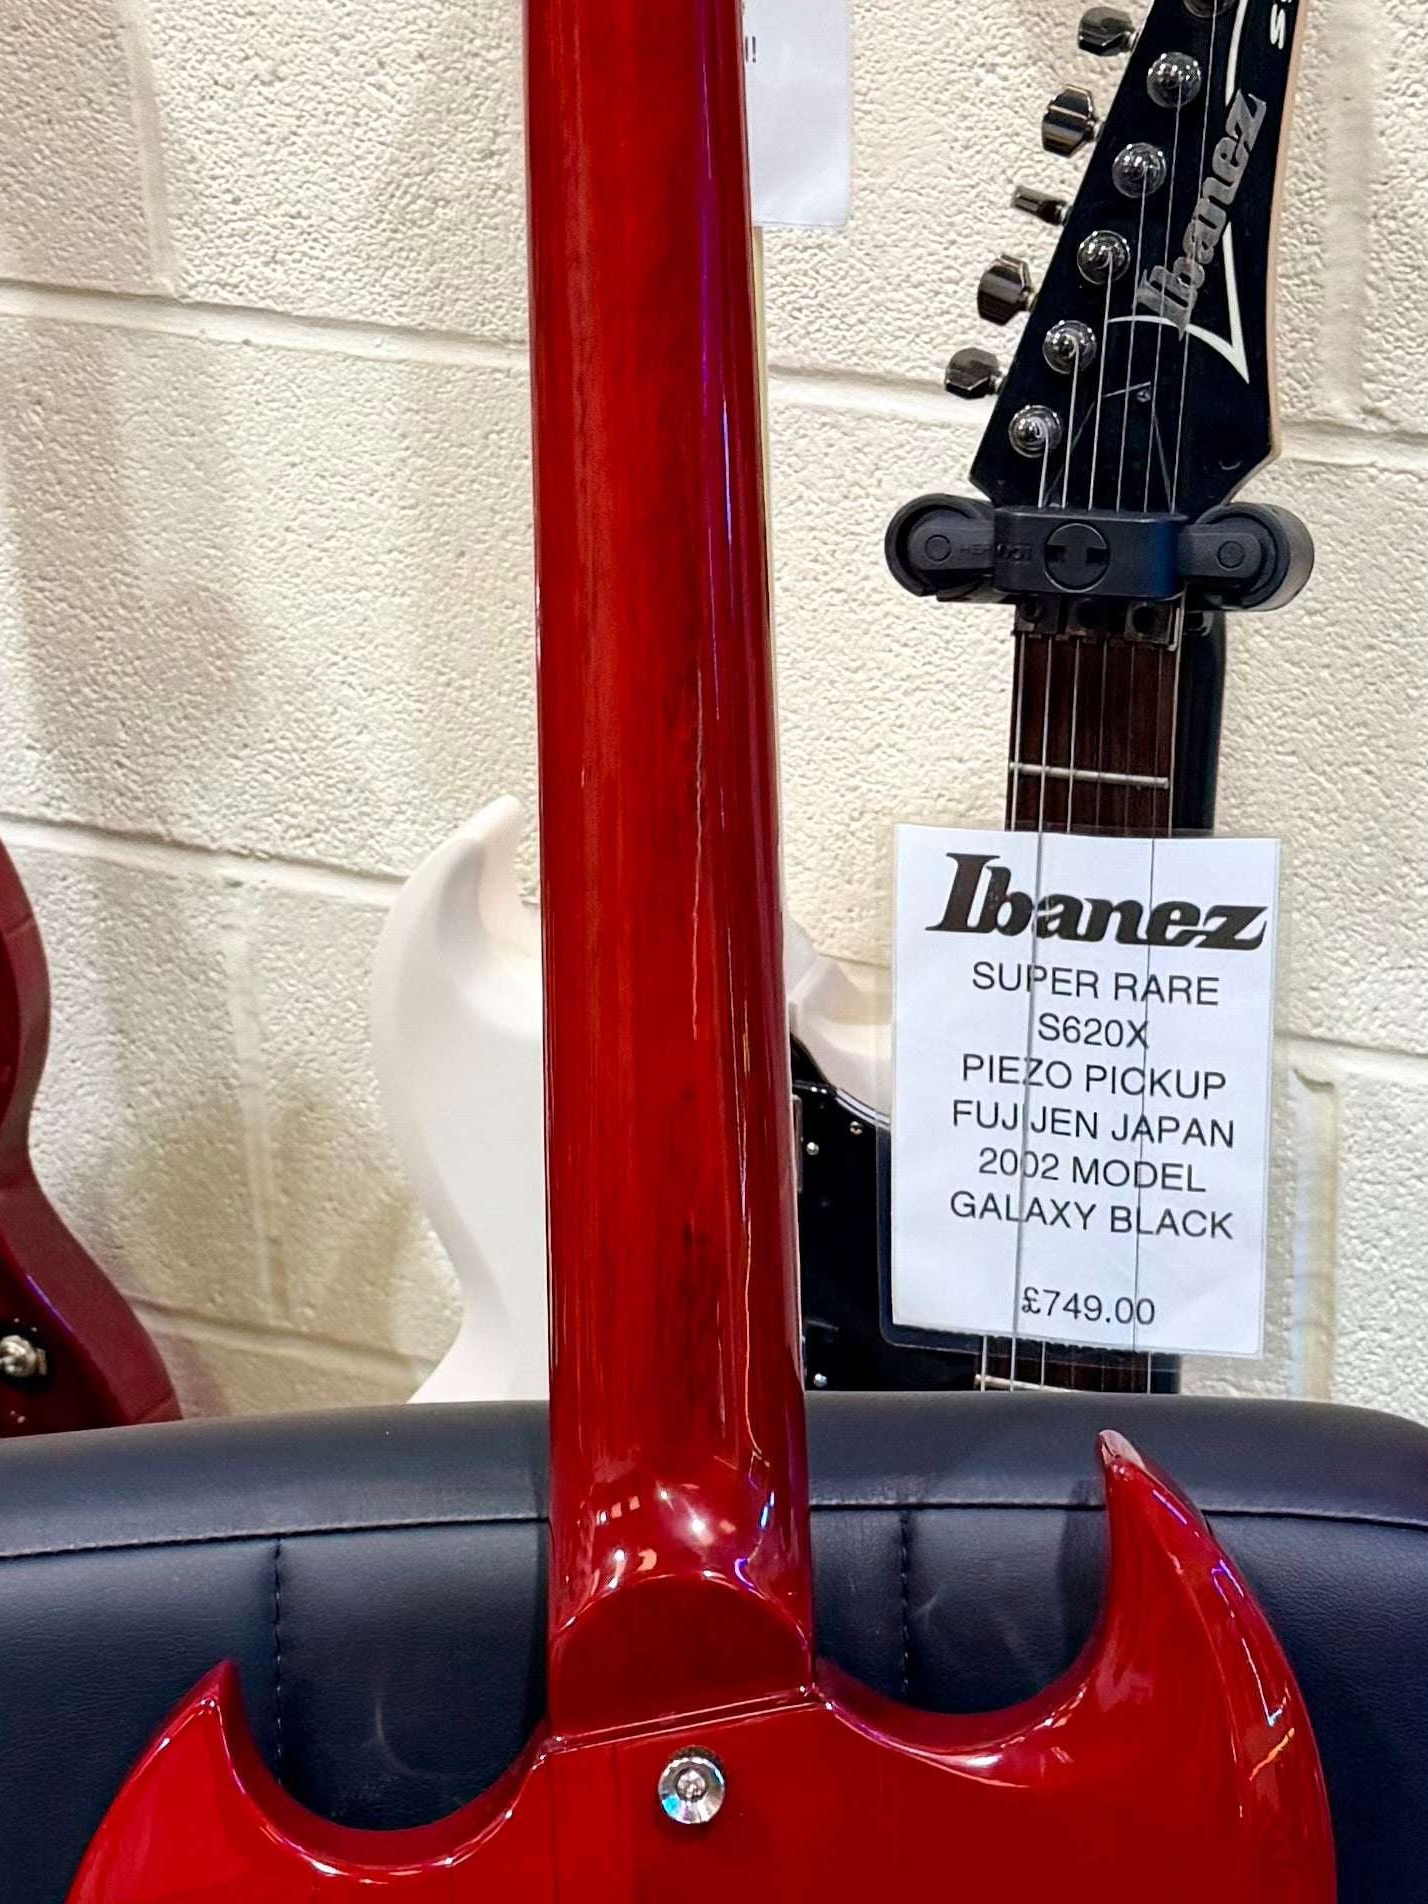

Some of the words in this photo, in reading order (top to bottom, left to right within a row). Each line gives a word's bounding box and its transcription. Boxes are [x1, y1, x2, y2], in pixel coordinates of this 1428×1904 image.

[1138, 88, 1267, 342] Ibanez
[925, 852, 1269, 951] Ibanez
[972, 961, 1099, 1001] SUPER
[1113, 970, 1221, 1007] RARE
[1037, 1012, 1150, 1050] S620X
[962, 1053, 1073, 1090] PIEZO
[1085, 1063, 1227, 1101] PICKUP
[1111, 1112, 1235, 1149] JAPAN
[978, 1146, 1060, 1182] 2002
[1071, 1155, 1208, 1193] MODEL
[950, 1189, 1097, 1230] GALAXY
[1109, 1205, 1234, 1240] BLACK
[1021, 1286, 1156, 1326] £749.00
